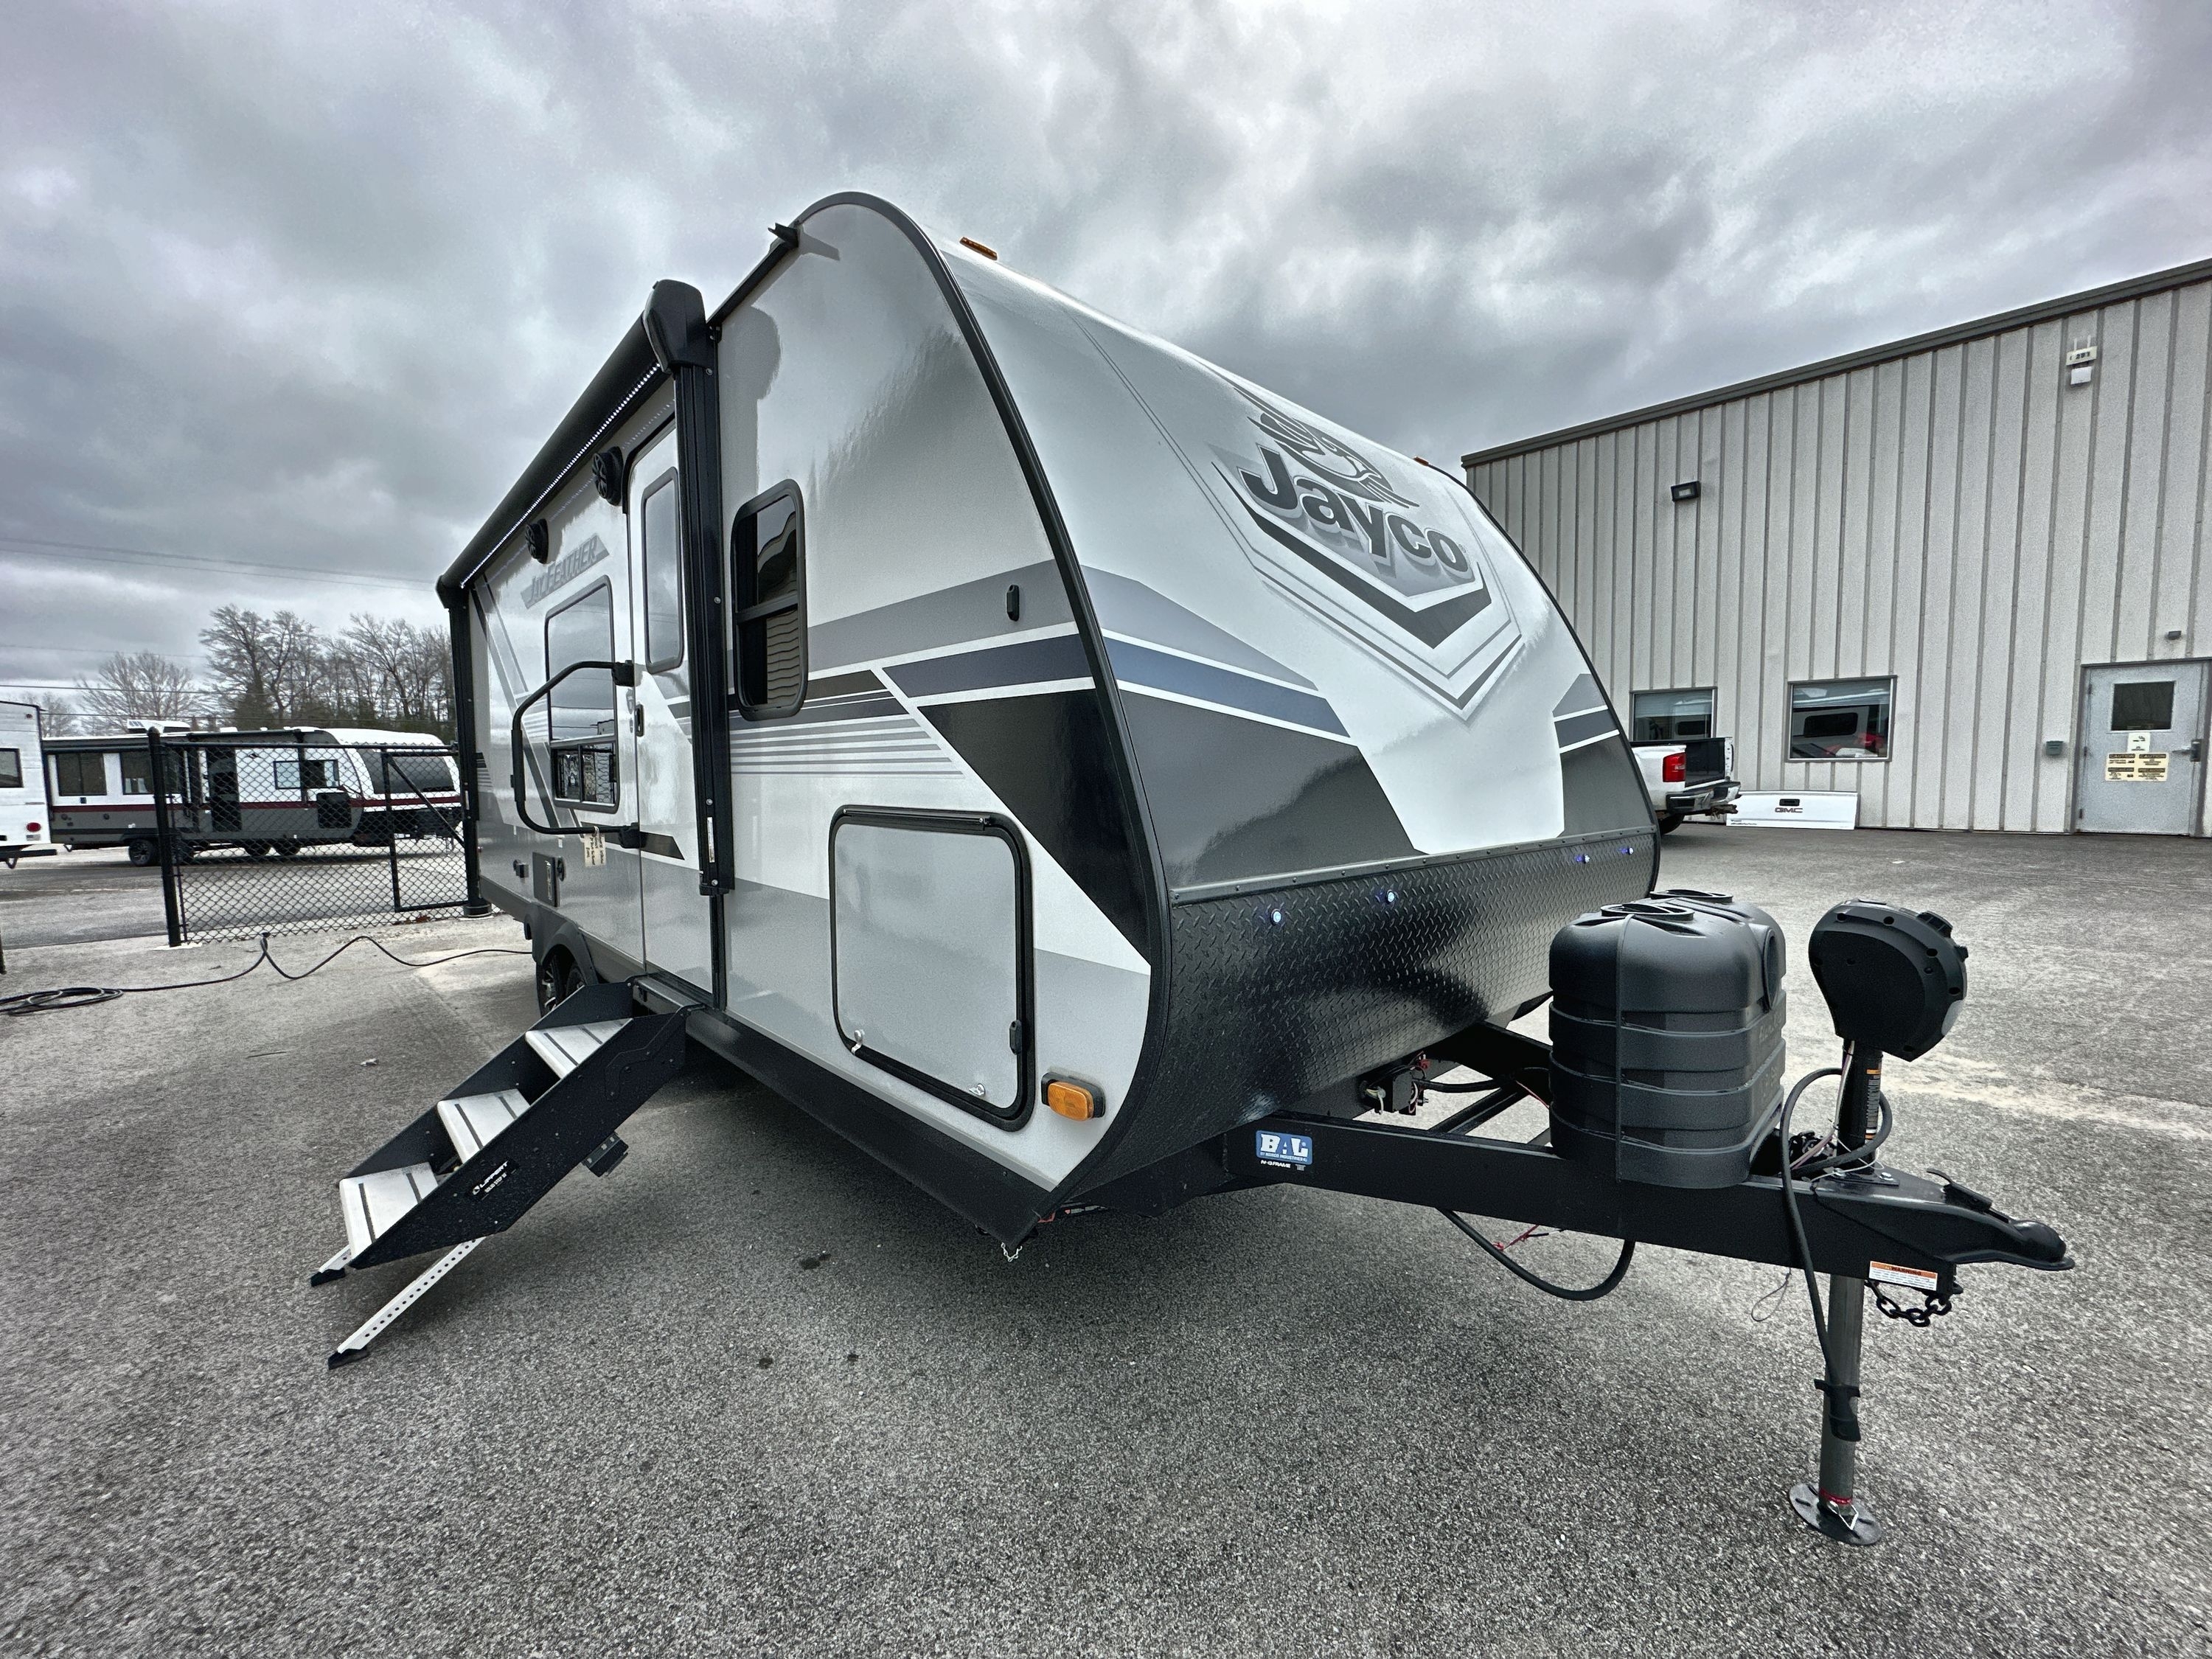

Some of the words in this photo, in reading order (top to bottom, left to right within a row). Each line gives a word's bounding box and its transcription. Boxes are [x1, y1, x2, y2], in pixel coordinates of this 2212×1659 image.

[1238, 444, 1472, 578] Jayco
[547, 534, 599, 591] FEATHER
[1260, 1134, 1309, 1157] BAL
[480, 1161, 509, 1188] LIPPERT
[1891, 1267, 1921, 1276] WARNING
